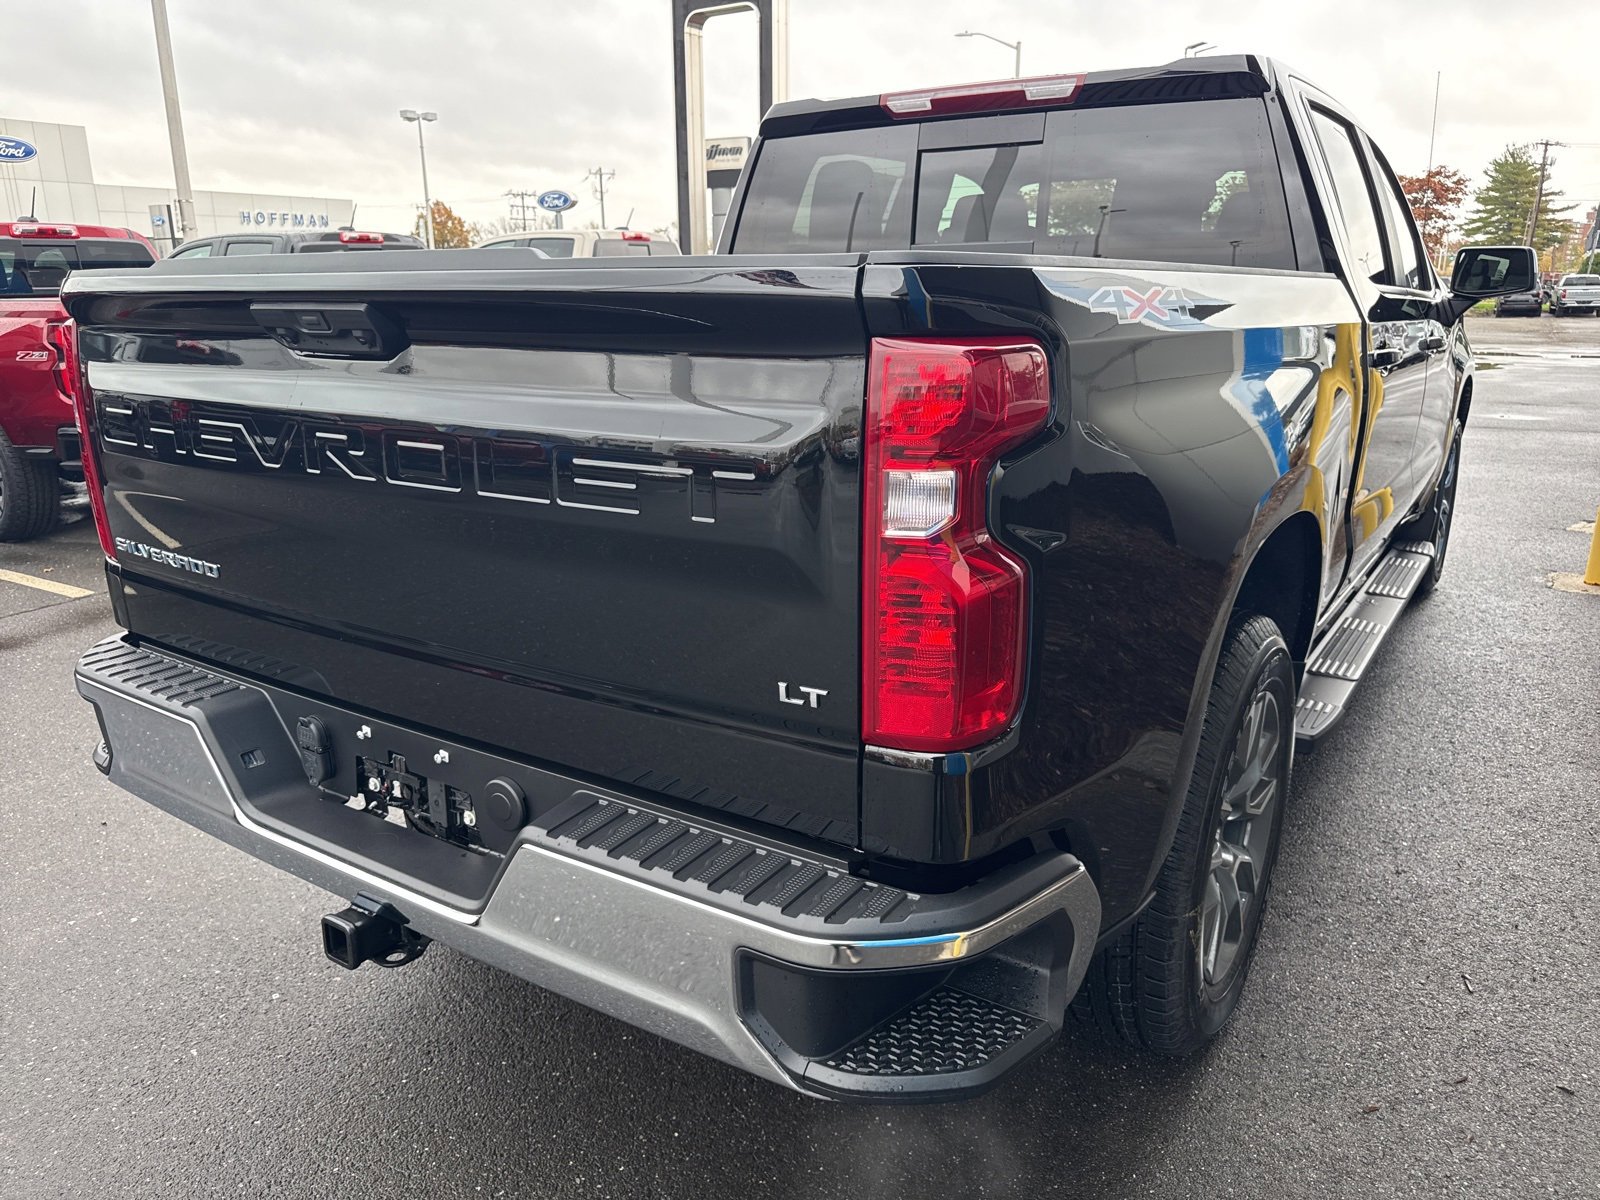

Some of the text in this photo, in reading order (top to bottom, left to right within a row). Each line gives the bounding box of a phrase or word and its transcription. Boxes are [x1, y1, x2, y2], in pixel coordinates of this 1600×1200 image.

[543, 194, 565, 208] Ford
[241, 211, 329, 227] HOFFMAN
[16, 350, 49, 362] Z71
[100, 400, 757, 524] CHEVROLET
[115, 536, 221, 579] SILVERADO
[777, 681, 830, 709] LT
